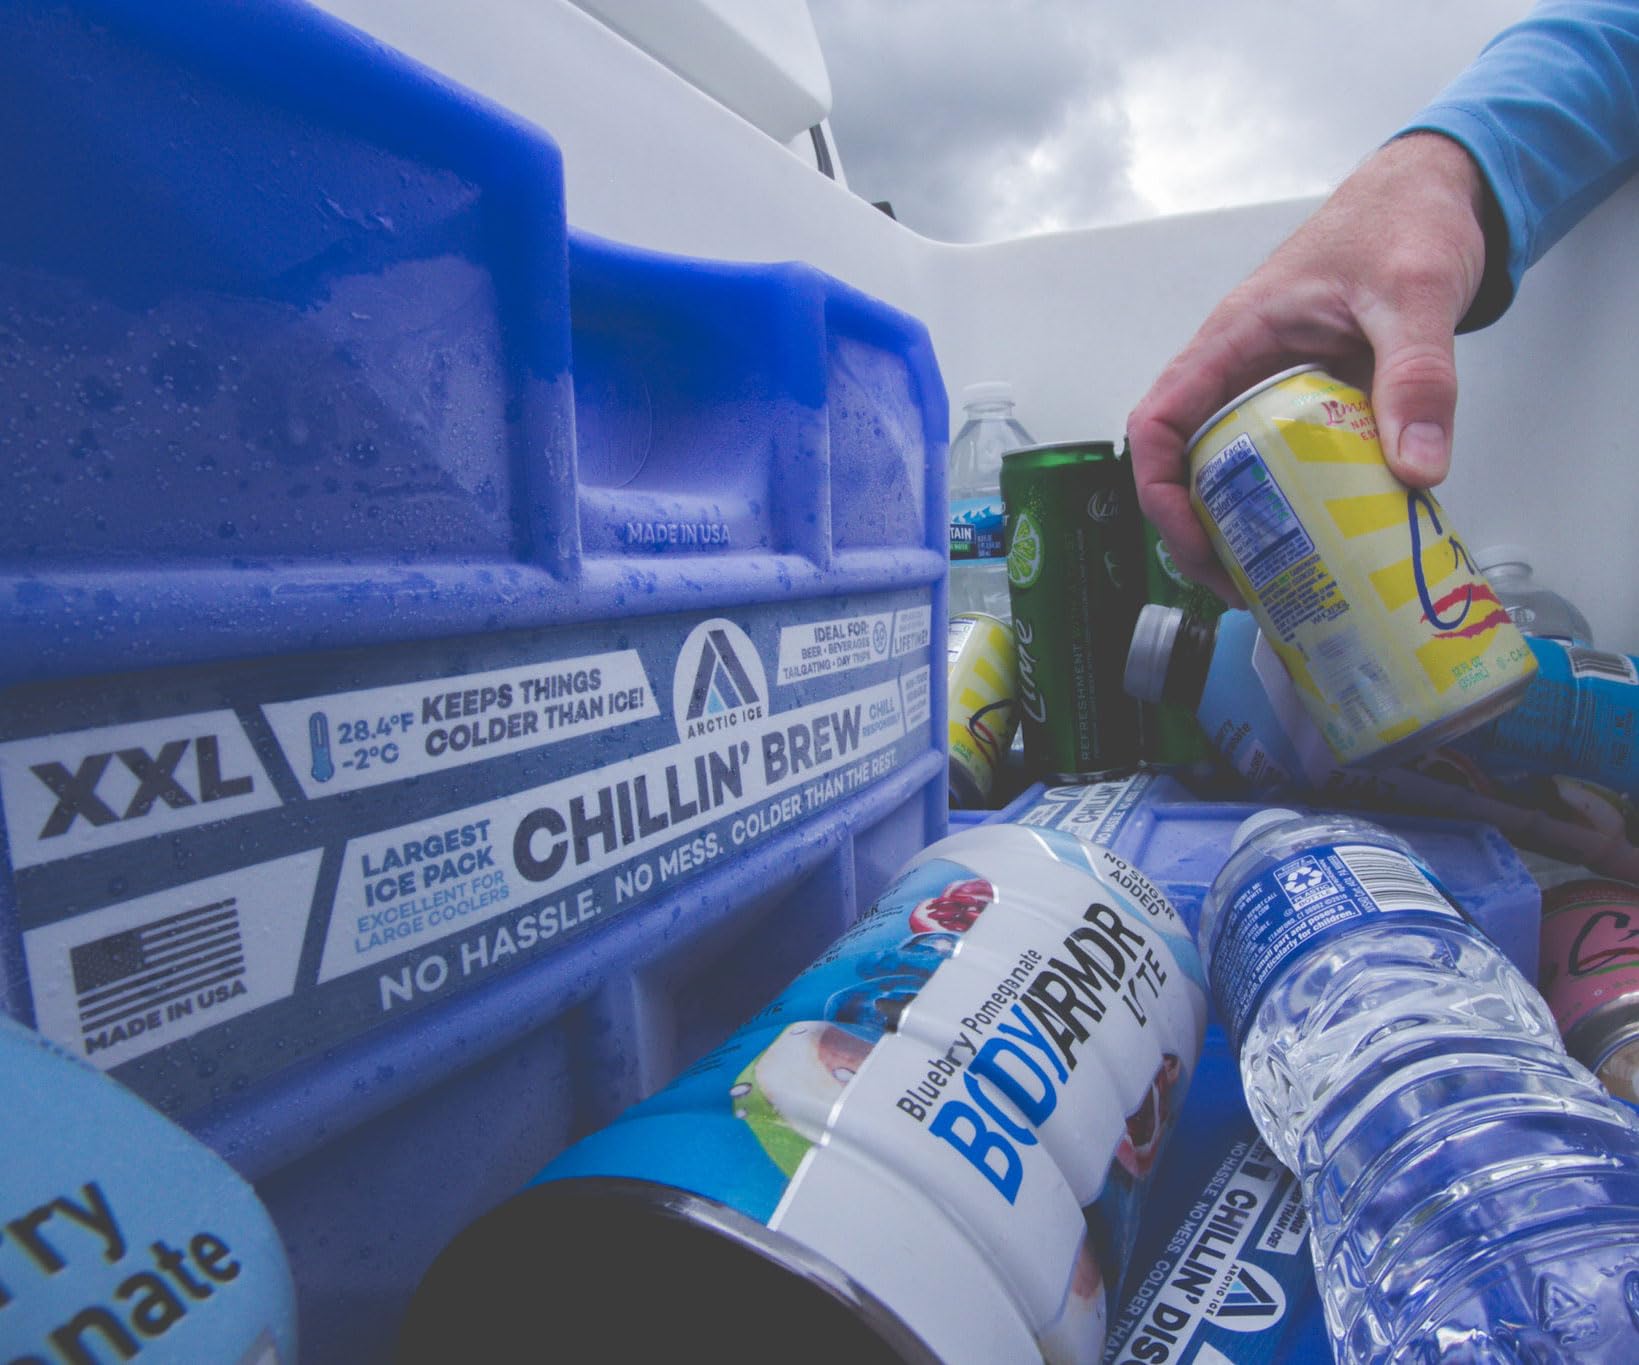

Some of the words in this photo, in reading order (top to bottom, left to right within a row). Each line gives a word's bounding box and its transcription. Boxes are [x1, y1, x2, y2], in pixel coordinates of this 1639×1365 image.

[625, 521, 677, 544] MADE
[680, 521, 698, 544] IN
[699, 522, 731, 544] USA
[801, 646, 822, 659] BEER
[828, 636, 870, 655] BEVERAGES
[814, 623, 846, 643] IDEAL
[847, 620, 869, 637] FOR:
[783, 659, 831, 680] TAILGATING
[836, 654, 851, 667] DAY
[420, 679, 514, 725] KEEPS
[519, 668, 603, 706] THINGS
[424, 708, 537, 757] COLDER
[543, 696, 604, 731] THAN
[607, 687, 645, 716] ICE!
[686, 713, 738, 739] ARCTIC
[742, 705, 763, 722] ICE
[869, 696, 895, 720] CHILL
[29, 734, 255, 841] XXL
[512, 739, 751, 883] CHILLIN'
[762, 703, 863, 787] BREW
[361, 819, 492, 878] LARGEST
[364, 871, 417, 908] ICE
[423, 845, 495, 888] PACK
[357, 881, 468, 934] EXCELLENT
[472, 870, 505, 900] FOR
[379, 954, 449, 1011] NO
[461, 888, 602, 977] HASSLE.
[613, 866, 653, 905] NO
[659, 829, 725, 877] MESS.
[731, 800, 803, 846] COLDER
[804, 779, 845, 811] THAN
[846, 763, 871, 793] THE
[871, 748, 898, 782] REST.
[1103, 852, 1128, 870] NO
[1128, 869, 1176, 921] SUGAR
[1109, 869, 1160, 917] ADDED
[1293, 882, 1330, 903] PLASTIC
[354, 916, 425, 954] LARGE
[429, 882, 510, 928] COOLERS
[1255, 948, 1273, 972] small
[1273, 932, 1290, 951] part
[1290, 921, 1307, 937] and
[1307, 906, 1336, 925] poses
[1338, 904, 1345, 912] a
[1257, 936, 1299, 984] particularly
[1298, 929, 1311, 941] for
[1313, 909, 1356, 932] children.
[83, 1008, 163, 1056] MADE
[165, 994, 195, 1021] IN
[198, 979, 248, 1012] USA
[1232, 1140, 1248, 1158] NO
[1188, 1200, 1209, 1224] NO
[1278, 1201, 1297, 1227] THAN
[1170, 1187, 1259, 1306] CHILLIN'
[1124, 1258, 1171, 1317] COLDER
[1205, 1299, 1221, 1317] ICE
[1215, 1263, 1239, 1298] ARCTIC
[1103, 1318, 1136, 1363] THAN
